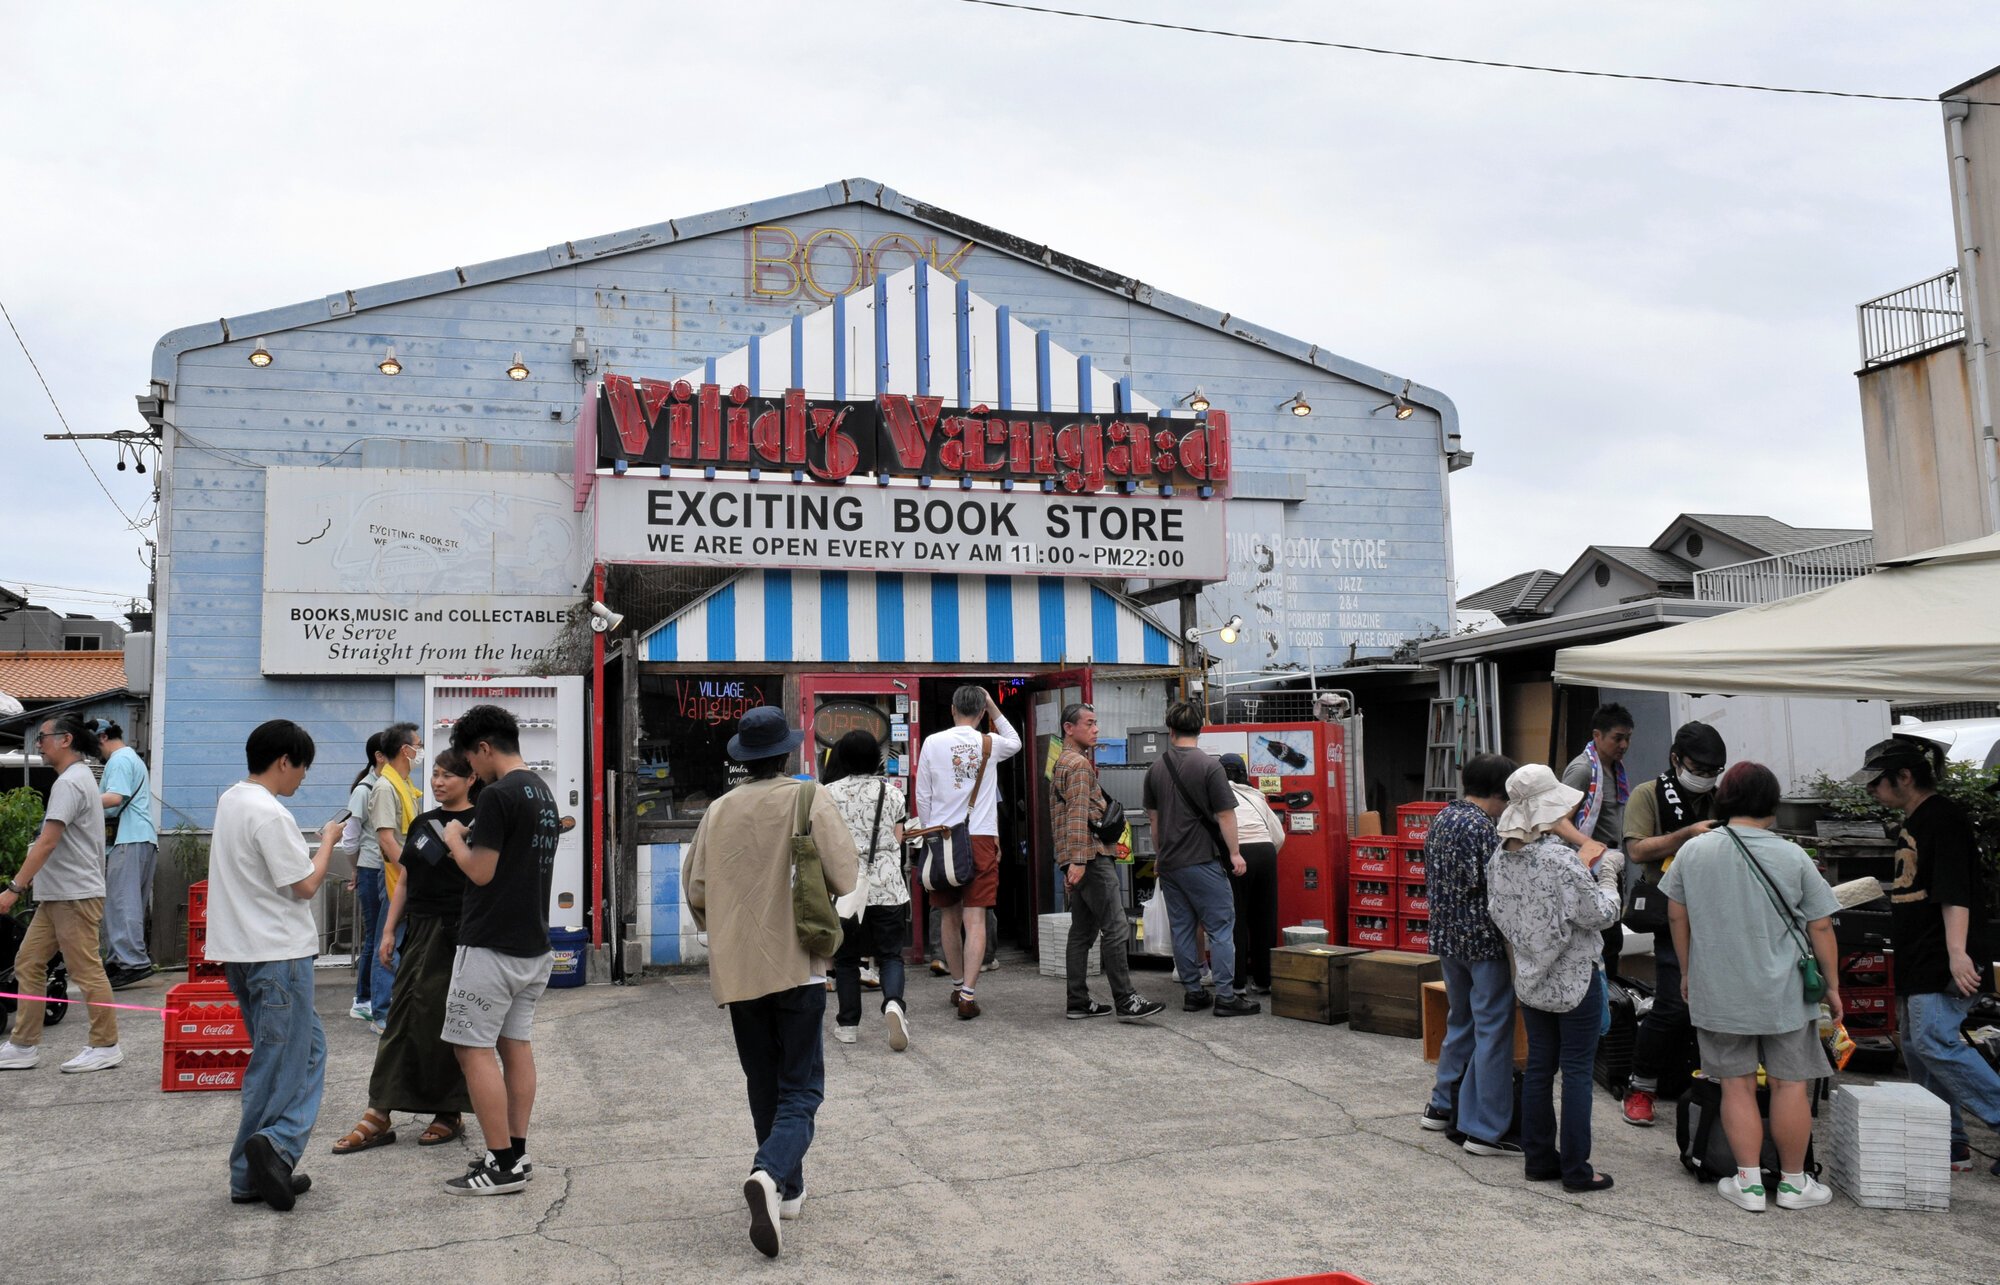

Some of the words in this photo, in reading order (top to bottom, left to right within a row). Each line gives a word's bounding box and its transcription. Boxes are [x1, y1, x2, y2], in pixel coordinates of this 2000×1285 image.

[744, 226, 976, 305] BOOK
[648, 490, 863, 531] EXCITING
[894, 498, 1018, 537] BOOK
[1046, 504, 1184, 542] STORE
[648, 534, 684, 553] WE
[694, 536, 742, 555] ARE
[752, 537, 817, 556] OPEN
[828, 540, 904, 559] EVERY
[915, 542, 960, 560] DAY
[1271, 531, 1322, 568] BOOK
[1331, 538, 1388, 569] STORE
[1338, 576, 1363, 592] JAZZ
[414, 610, 443, 622] and
[449, 610, 576, 624] COLLECTABLES
[1339, 613, 1381, 629] MAGAZINE
[304, 623, 335, 640] We
[342, 623, 397, 640] Serve
[1295, 632, 1324, 647] GOODS
[1340, 631, 1375, 647] VINTAGE
[328, 642, 414, 665] Straight
[416, 643, 467, 665] from
[474, 643, 505, 660] the
[699, 681, 744, 698] VILLAGE
